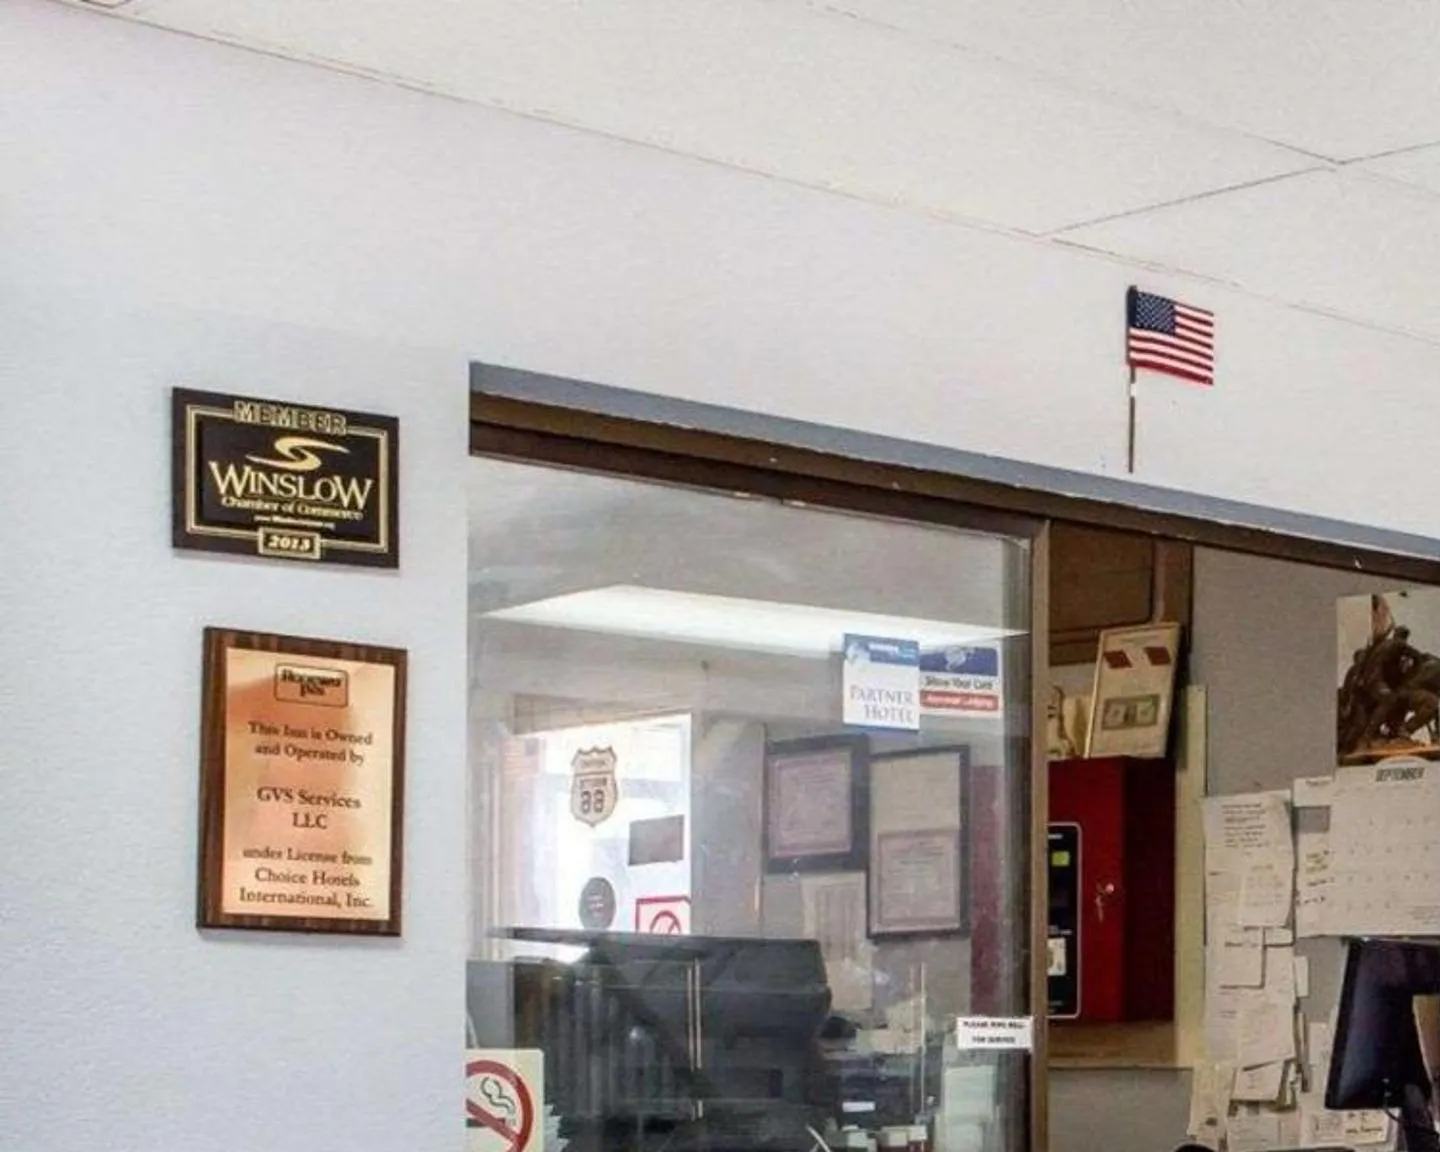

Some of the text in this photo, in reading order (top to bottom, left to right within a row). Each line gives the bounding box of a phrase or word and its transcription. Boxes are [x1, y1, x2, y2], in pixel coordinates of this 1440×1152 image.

[234, 401, 346, 435] MEMBER
[208, 460, 375, 510] WINSLOW
[221, 496, 364, 520] Chamber of Commerce
[851, 685, 914, 705] PARTNER
[248, 721, 373, 745] This Inn is Owned
[255, 743, 364, 766] and Operated by
[256, 787, 361, 809] GVS Services
[293, 812, 328, 830] LLC
[243, 847, 372, 866] under License from
[255, 868, 360, 887] Choice Hotels
[240, 887, 374, 908] International, Inc.
